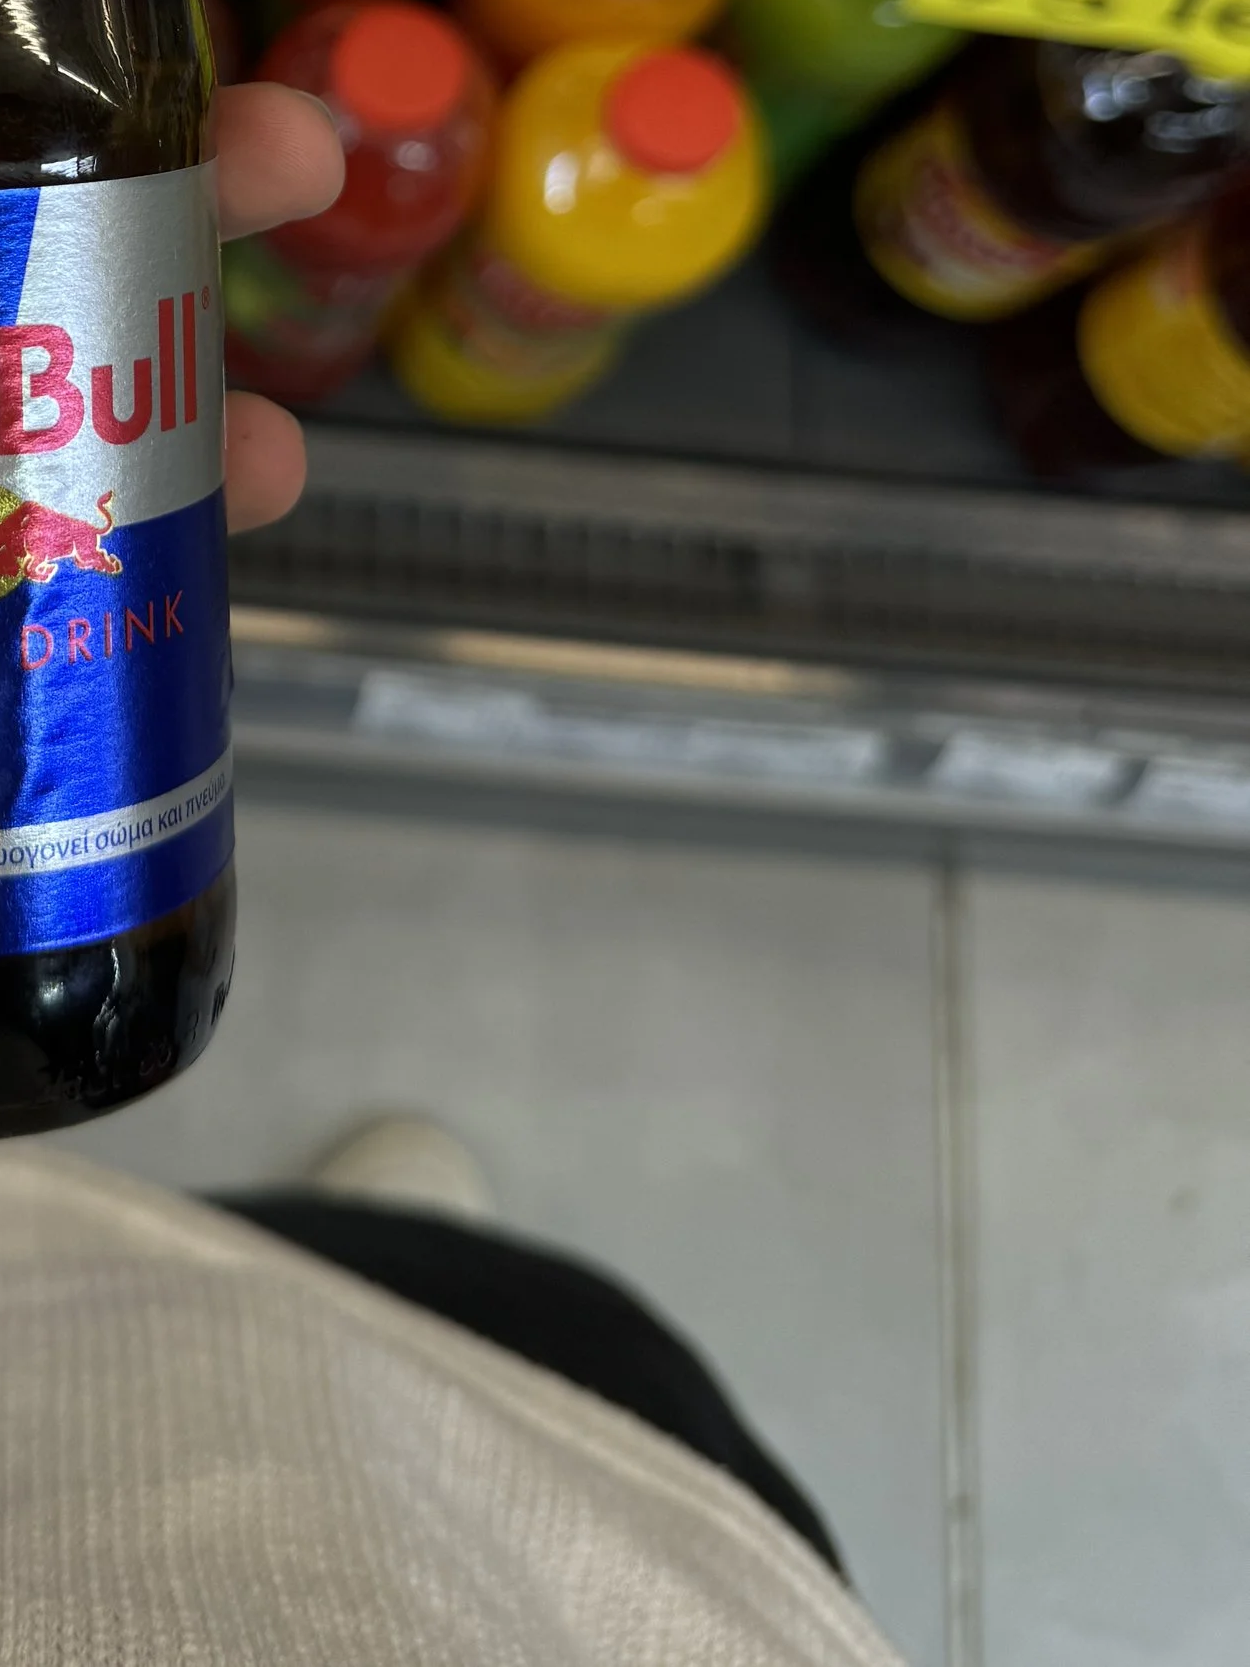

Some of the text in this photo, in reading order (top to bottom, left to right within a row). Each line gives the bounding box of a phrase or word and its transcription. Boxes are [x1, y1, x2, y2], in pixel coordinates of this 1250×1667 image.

[20, 589, 185, 672] DRINK
[94, 816, 153, 851] σώμα
[158, 803, 183, 832] και
